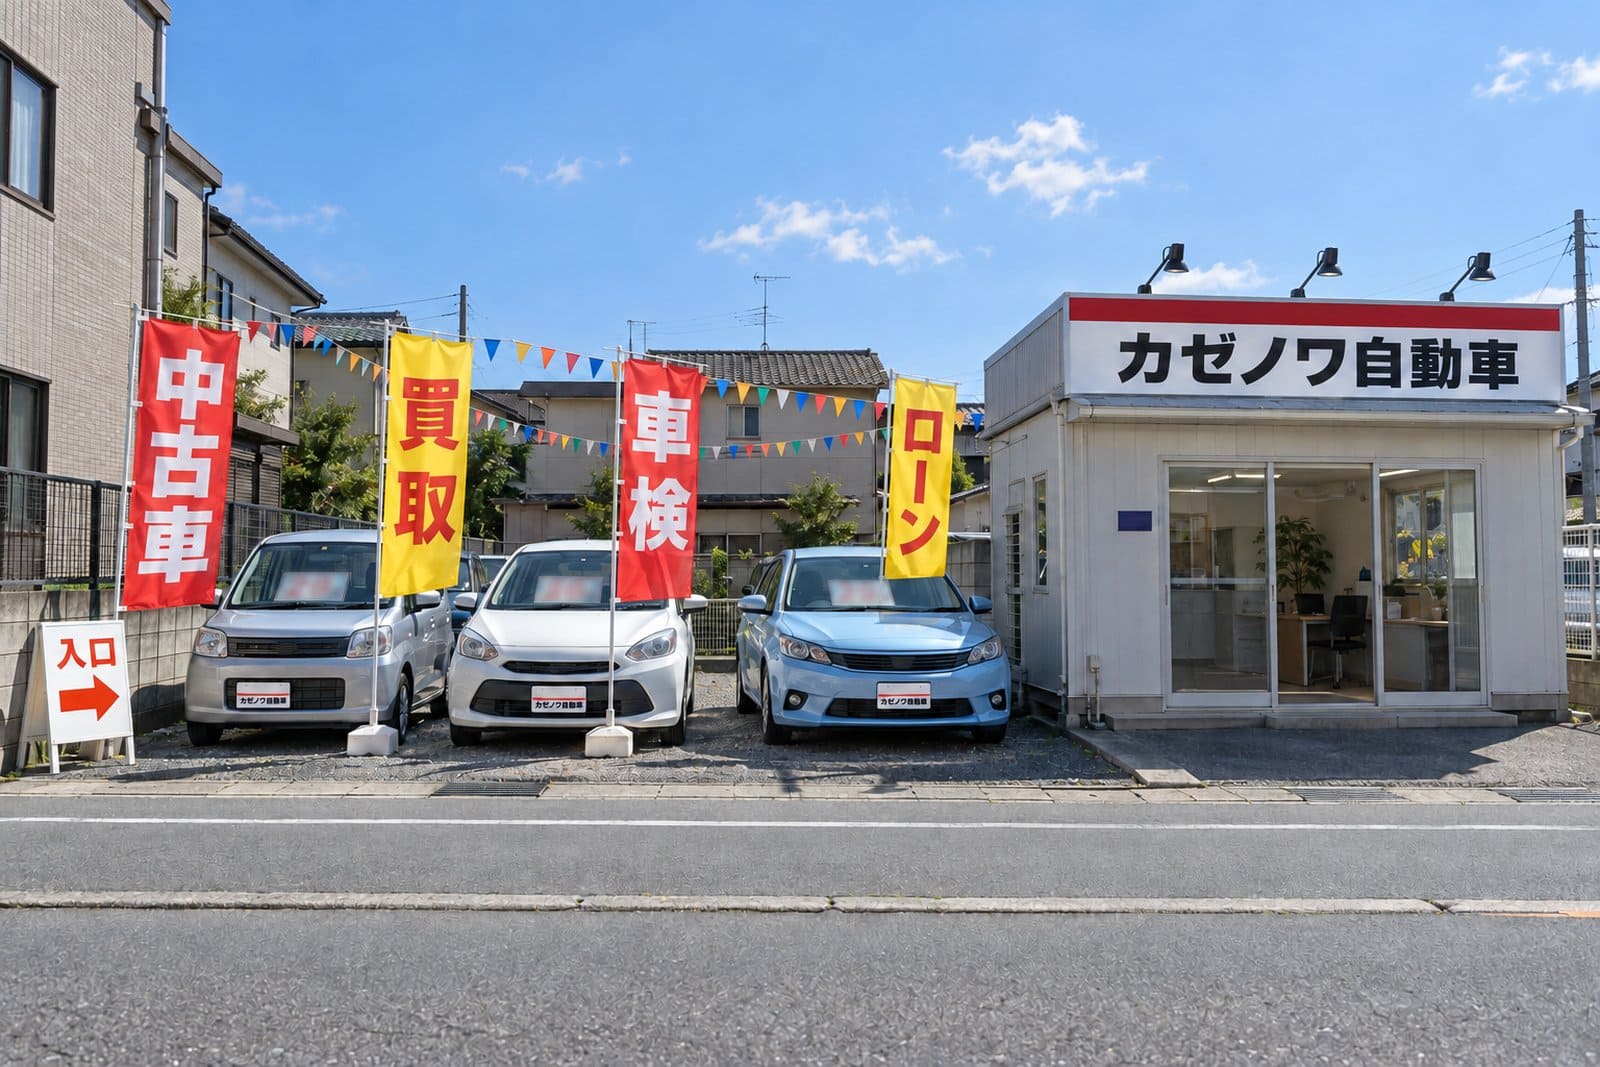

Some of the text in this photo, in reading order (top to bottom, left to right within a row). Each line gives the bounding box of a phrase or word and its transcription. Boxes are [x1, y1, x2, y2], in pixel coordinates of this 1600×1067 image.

[1118, 332, 1519, 391] カゼノワ自動車
[138, 349, 225, 583] 中古車
[395, 377, 459, 546] 買取
[629, 390, 692, 552] 車検
[900, 408, 944, 556] ローン
[57, 638, 117, 670] 入口
